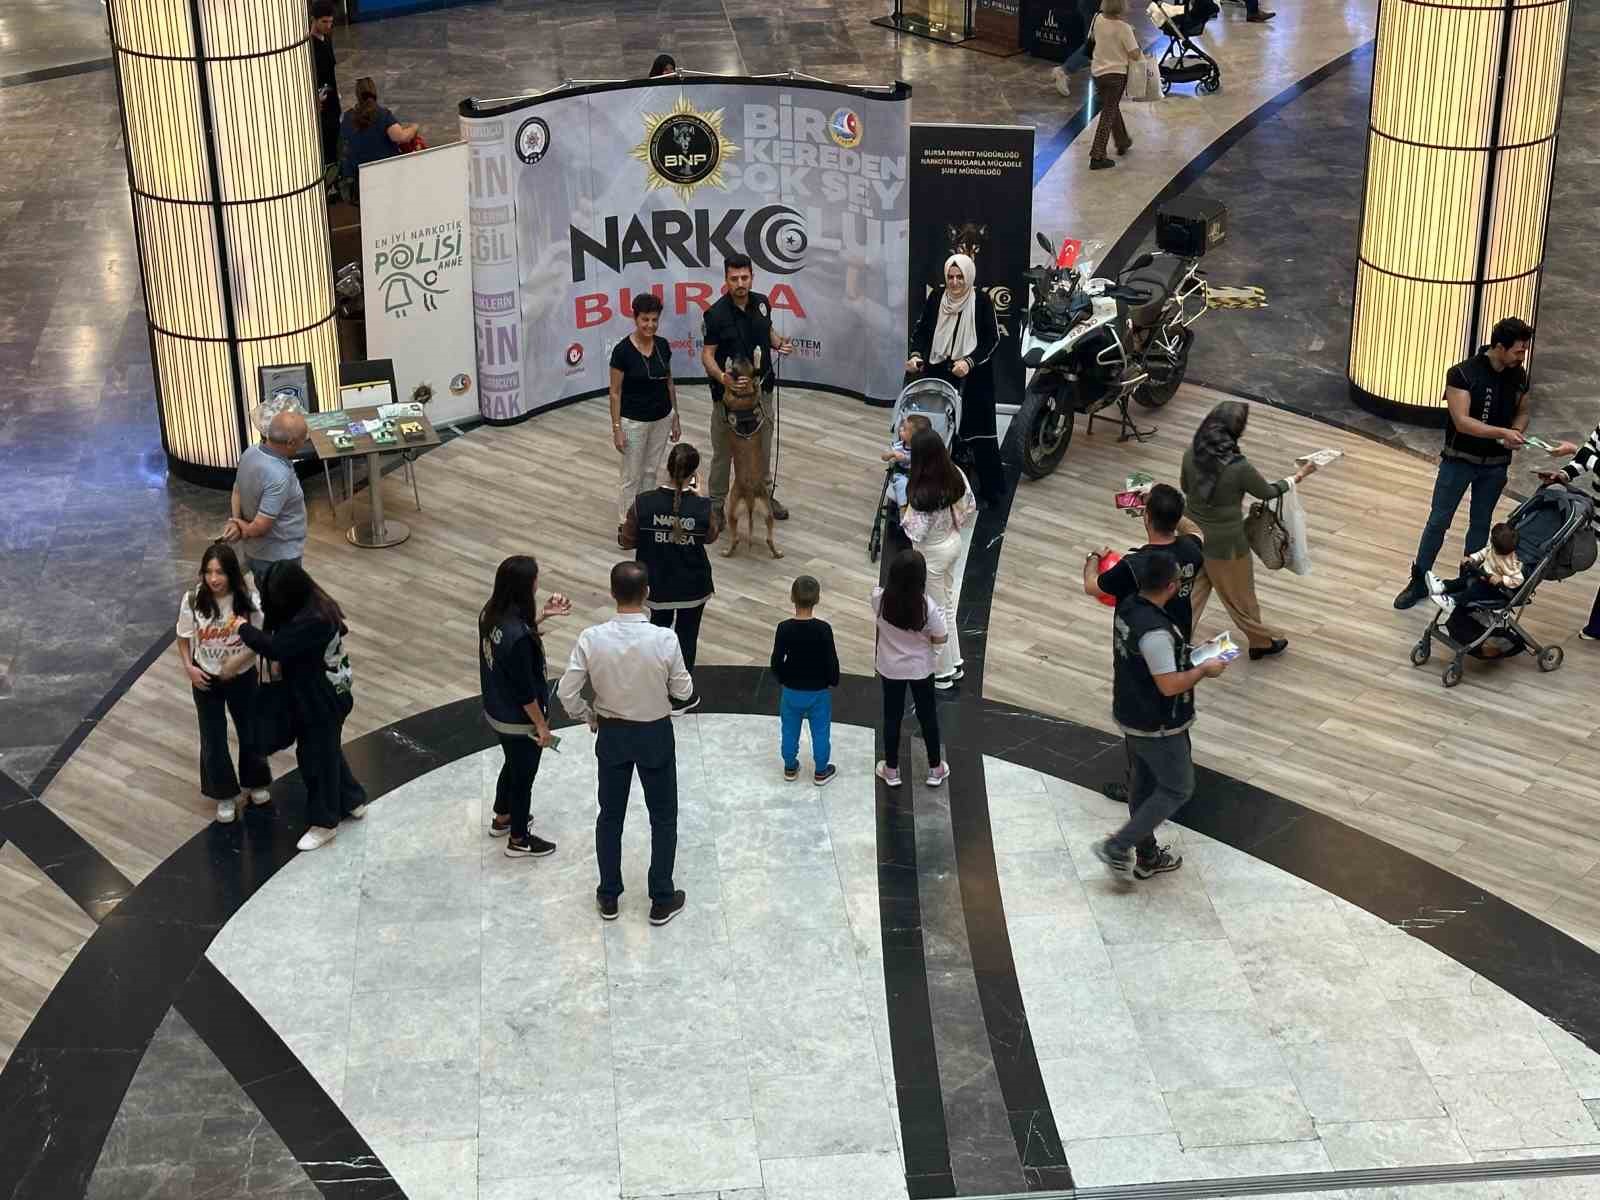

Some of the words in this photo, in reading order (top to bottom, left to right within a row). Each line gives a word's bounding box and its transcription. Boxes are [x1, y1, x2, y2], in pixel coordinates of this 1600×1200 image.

[744, 94, 829, 144] BİR
[664, 154, 706, 167] BNP
[744, 138, 906, 180] KEREDEN
[375, 229, 462, 275] POLİSİ
[376, 237, 388, 249] EN
[438, 256, 463, 270] ANNE
[575, 281, 807, 330] BURA
